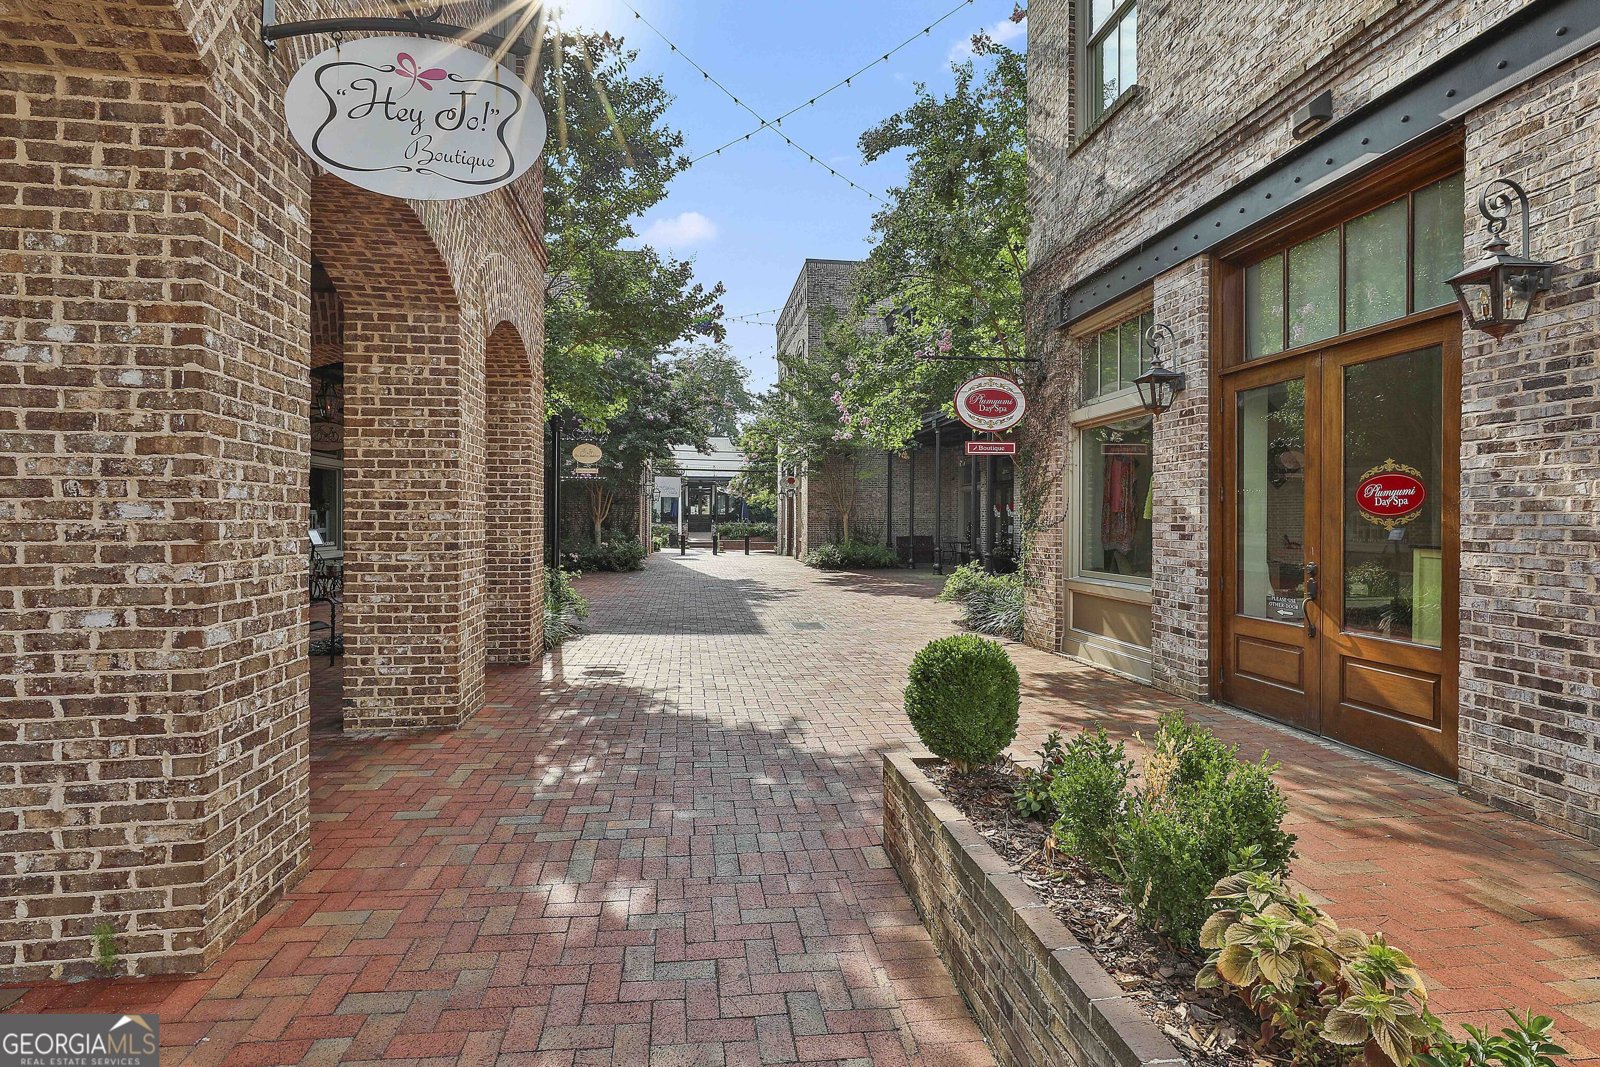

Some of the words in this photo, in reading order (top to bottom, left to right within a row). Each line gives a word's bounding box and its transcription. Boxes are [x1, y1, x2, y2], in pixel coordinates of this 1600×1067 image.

[404, 134, 496, 174] Boutique
[969, 392, 1014, 408] Plumyumi
[979, 404, 993, 413] Day
[994, 404, 1008, 413] Spa
[1363, 483, 1416, 499] Plumyumi
[1375, 497, 1391, 507] Day
[1393, 496, 1408, 507] Spa
[1271, 595, 1287, 603] PLEASE
